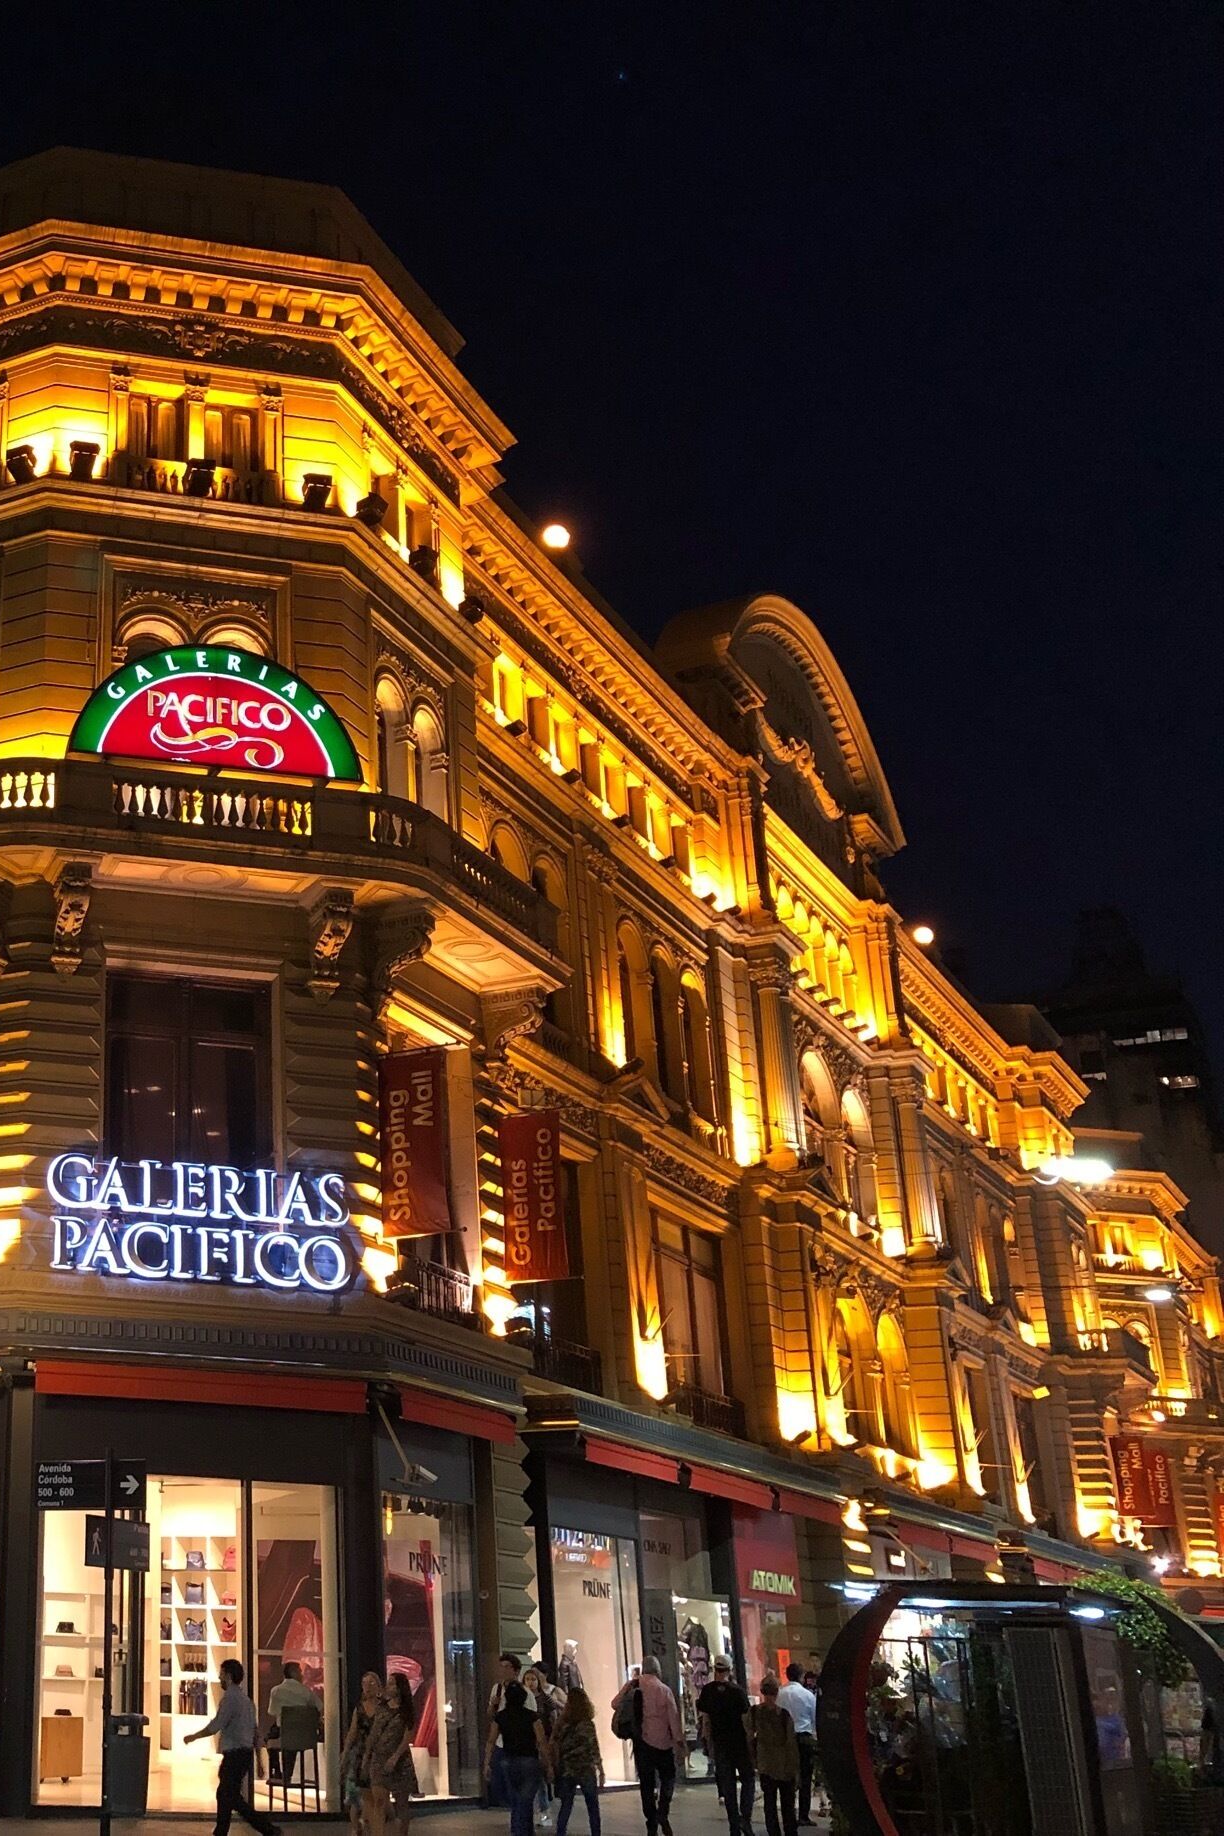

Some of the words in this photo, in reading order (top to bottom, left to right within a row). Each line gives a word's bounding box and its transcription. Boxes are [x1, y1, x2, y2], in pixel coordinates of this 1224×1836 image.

[106, 650, 326, 722] GALERIAS
[147, 690, 292, 732] PACIFICO
[411, 1070, 434, 1127] Mall
[386, 1089, 412, 1221] Shopping
[46, 1152, 351, 1229] GALERIAS
[49, 1215, 352, 1291] PACIFICO
[38, 1463, 72, 1473] Avenida
[1127, 1442, 1144, 1470] Mall
[38, 1474, 73, 1484] Córdoba
[38, 1487, 53, 1497] 500
[59, 1487, 74, 1497] 600
[1117, 1450, 1136, 1510] Shopping
[582, 1578, 612, 1600] PRÜNE
[752, 1569, 797, 1597] ATOMIK
